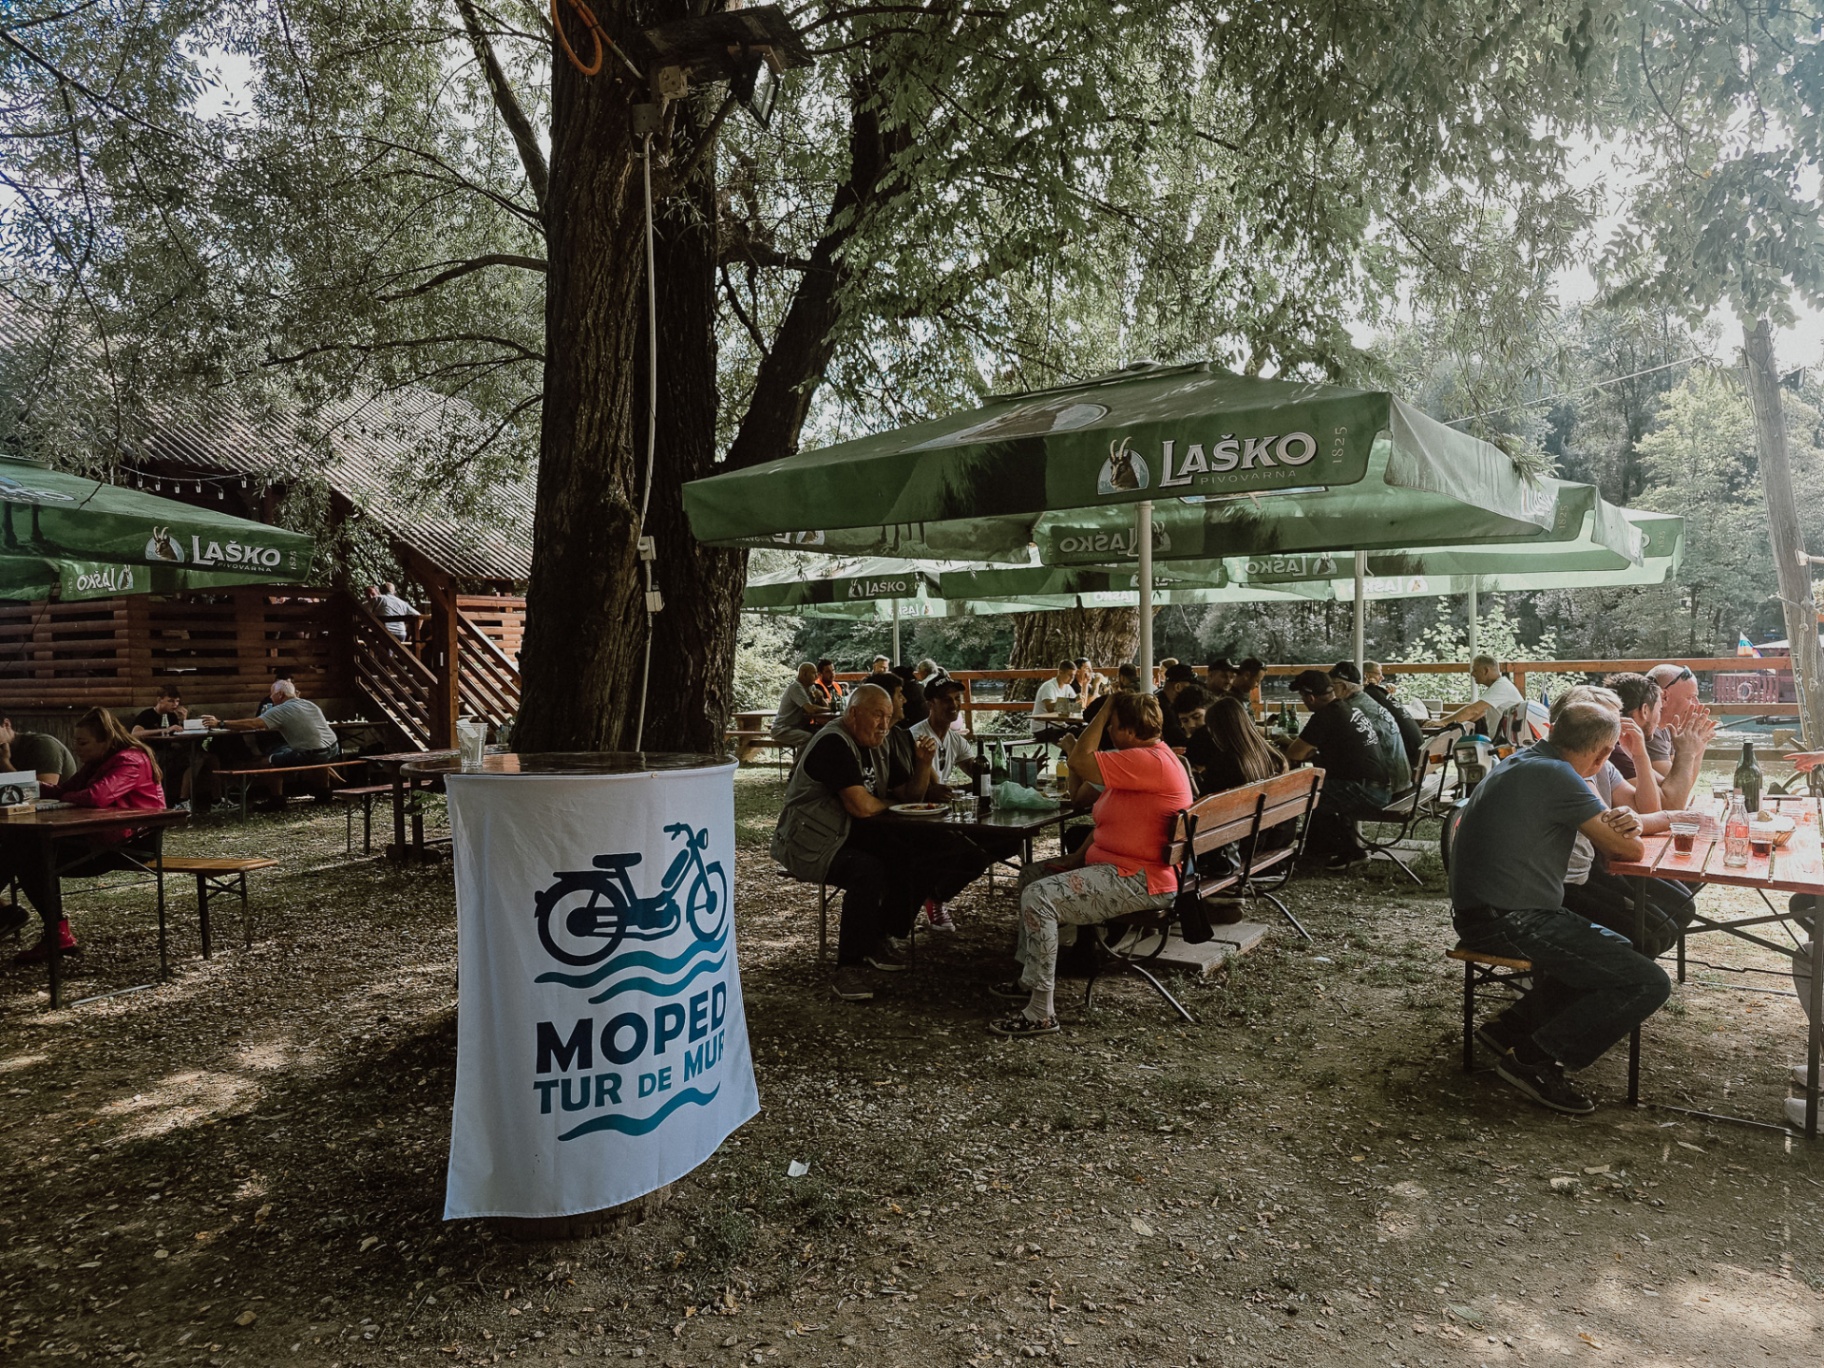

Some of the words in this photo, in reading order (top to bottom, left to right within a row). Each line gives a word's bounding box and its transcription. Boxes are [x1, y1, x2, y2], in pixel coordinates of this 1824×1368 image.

[1158, 431, 1318, 488] LAŠKO
[1331, 426, 1348, 464] 1825
[1200, 470, 1297, 486] PIVOVARNA
[191, 534, 281, 566] LAŠKO
[536, 981, 727, 1074] MOPED
[533, 1072, 622, 1115] TUR
[638, 1066, 672, 1099] DE
